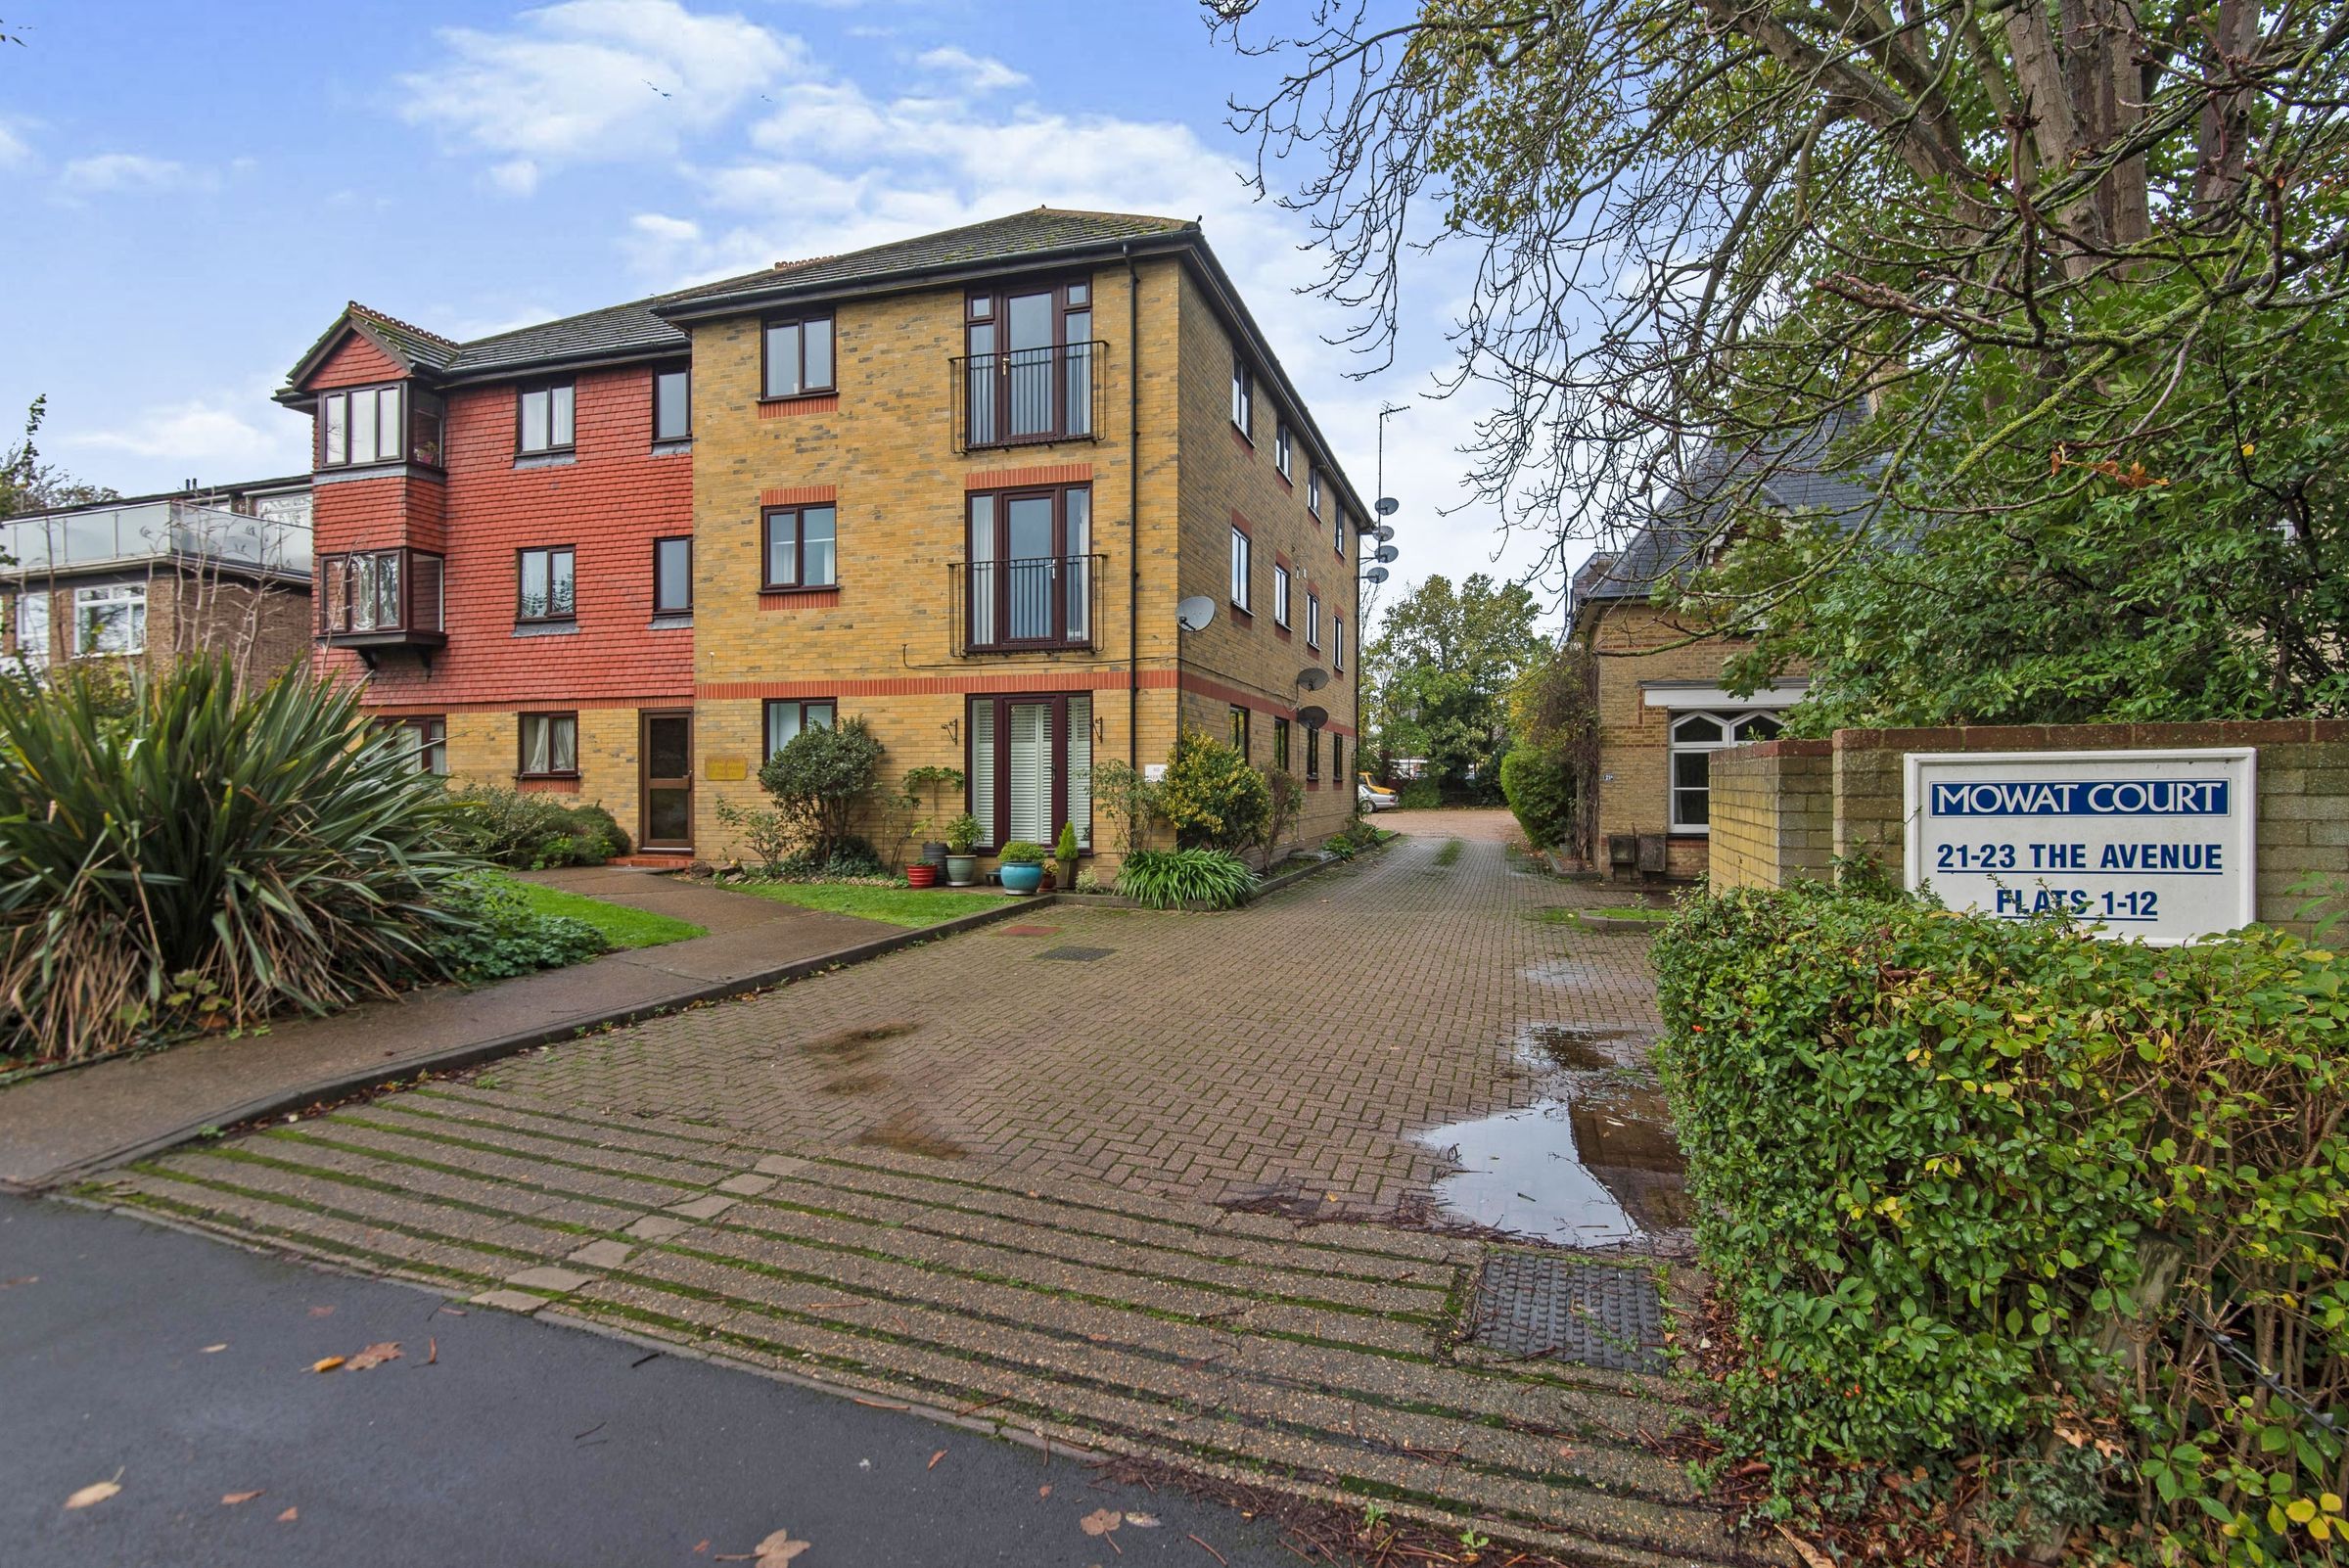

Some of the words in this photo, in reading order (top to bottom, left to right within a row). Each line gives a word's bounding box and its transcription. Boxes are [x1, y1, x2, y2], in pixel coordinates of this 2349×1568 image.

[1938, 784, 2078, 812] MOWAT
[2088, 782, 2221, 811] COURT
[1937, 844, 2015, 868] 21-23
[2029, 844, 2086, 868] THE
[2100, 844, 2222, 869] AVENUE
[1997, 890, 2087, 914] FLATS
[2101, 891, 2157, 915] 1-12
